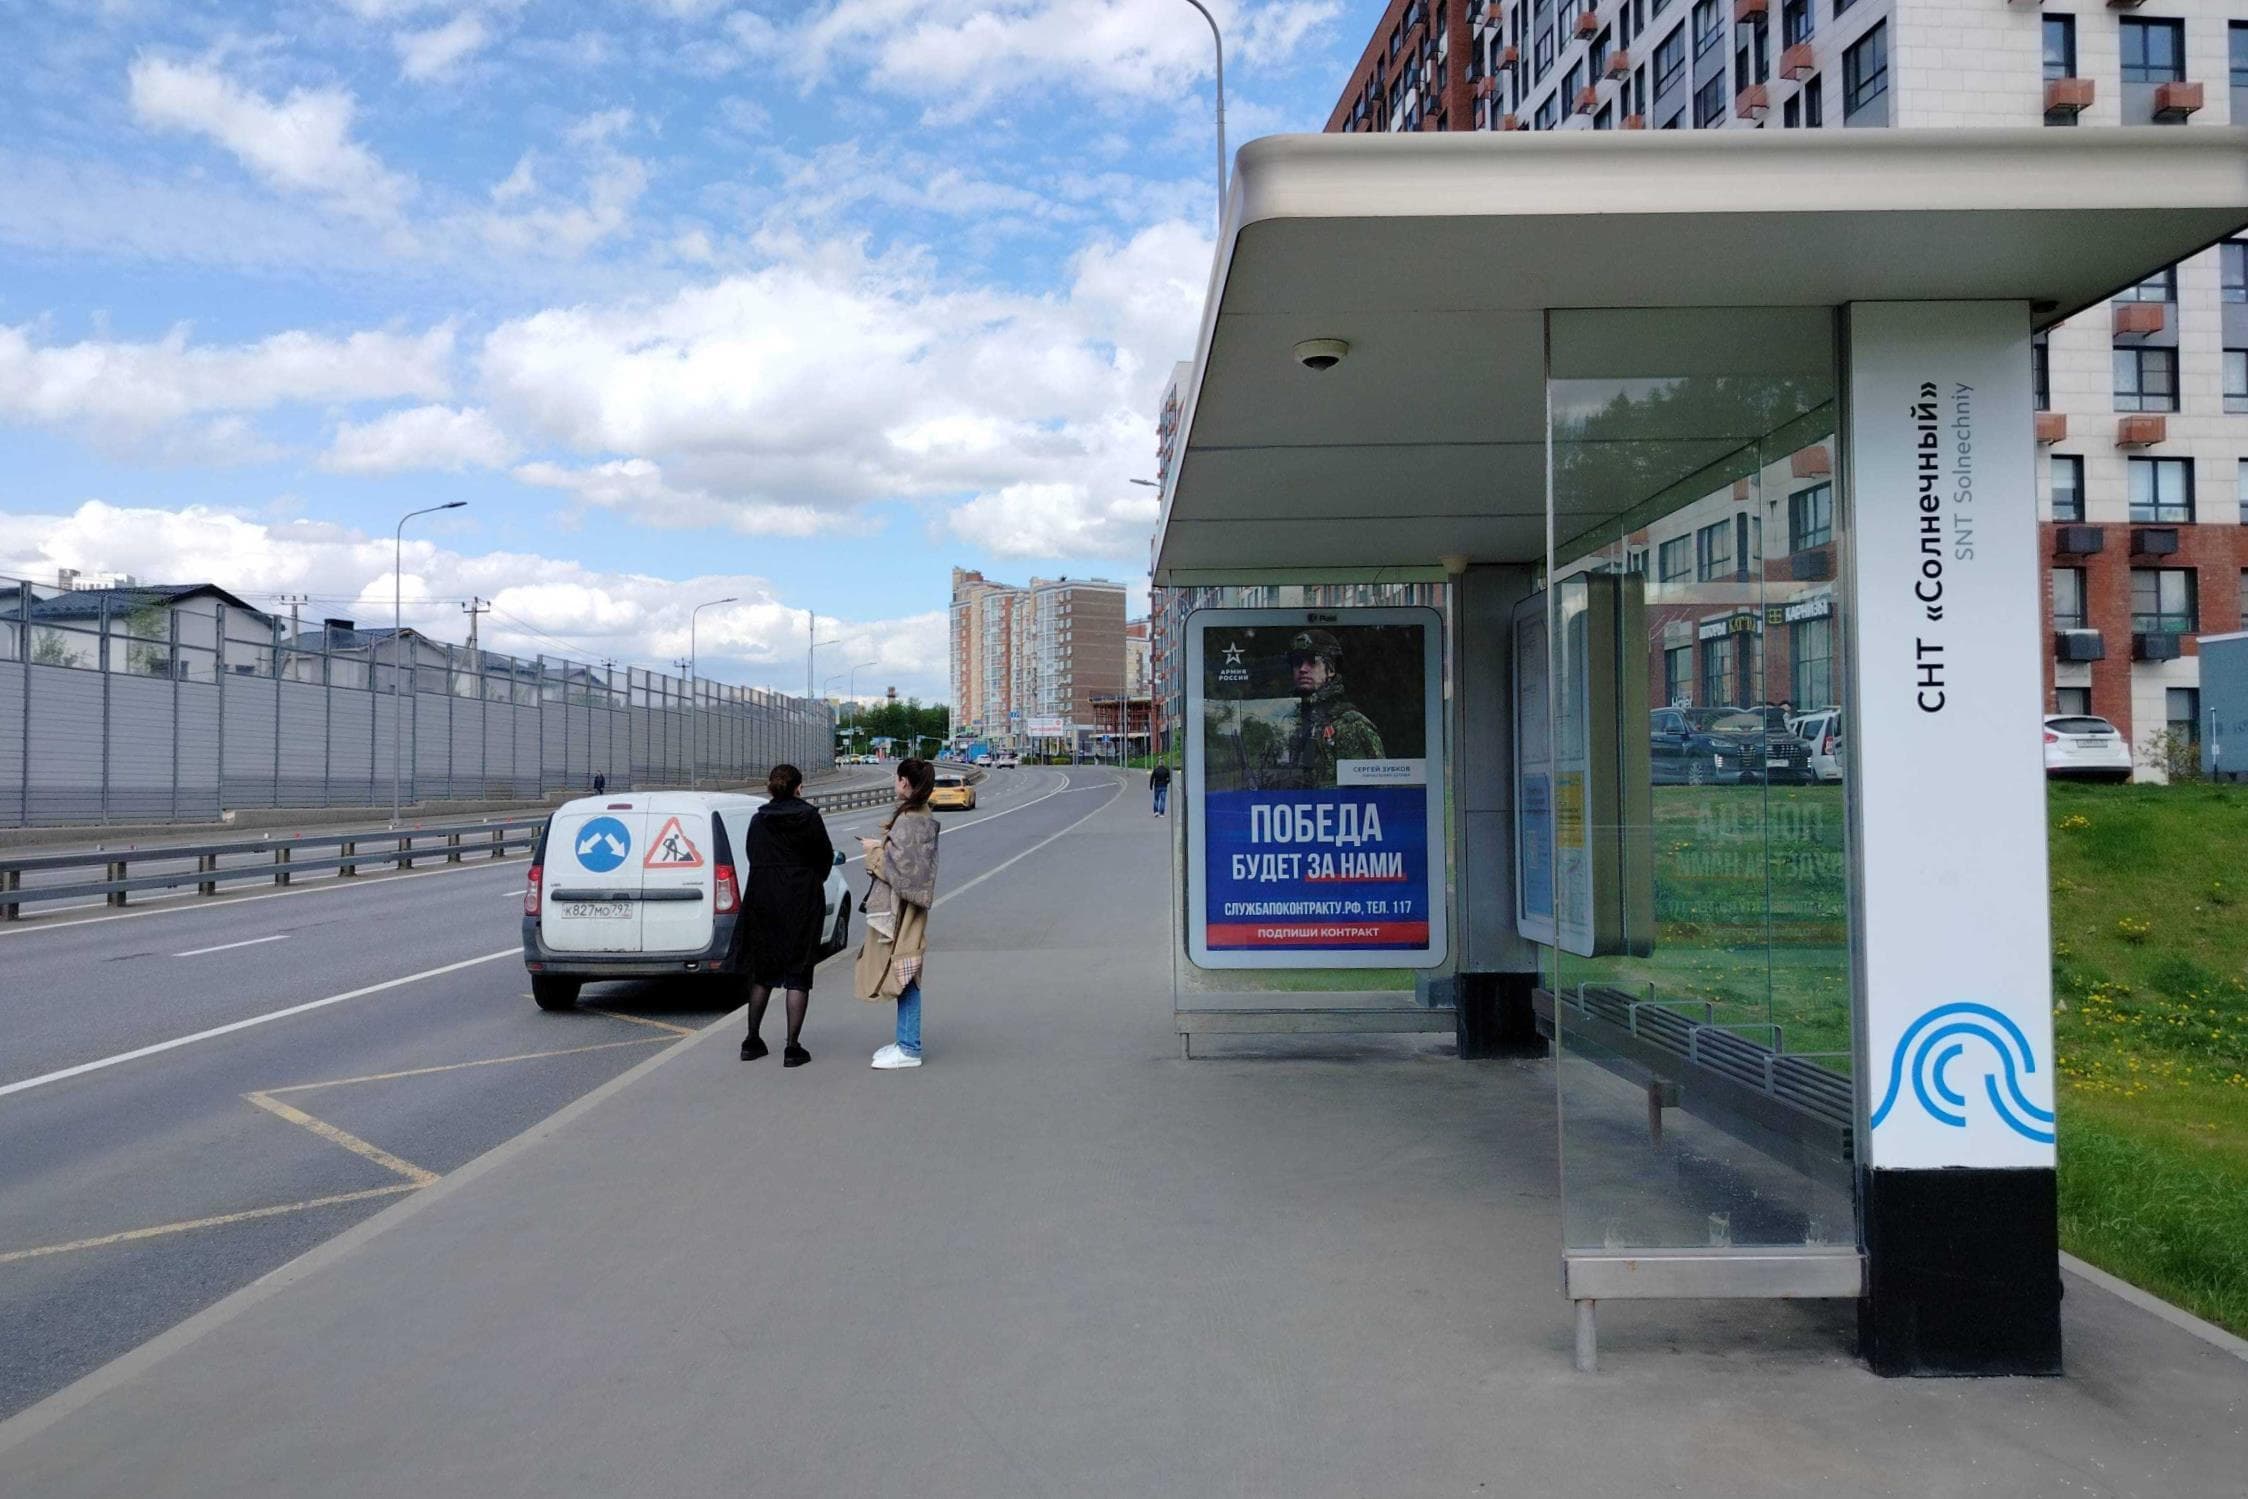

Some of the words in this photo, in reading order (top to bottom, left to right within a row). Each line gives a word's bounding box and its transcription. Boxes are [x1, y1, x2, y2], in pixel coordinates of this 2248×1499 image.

[1951, 382, 1975, 503] Solnechniy
[1910, 381, 1944, 622] «Солнечный»
[1954, 513, 1974, 561] SNT
[1916, 637, 1946, 713] СНТ
[1353, 765, 1380, 773] СЕРГЕЙ
[1251, 803, 1383, 847] ПОБЕДА
[1232, 853, 1302, 882] БУДЕТ
[1308, 852, 1335, 879] ЗА
[1341, 852, 1403, 879] НАМИ
[1225, 901, 1364, 916] СЛУЖБАПОКОНТРАКТУ.РФ,
[1367, 901, 1389, 915] ТЕЛ.
[1393, 900, 1412, 914] 117
[1257, 928, 1318, 939] ПОДПИШИ
[1321, 927, 1380, 938] КОНТРАКТ
